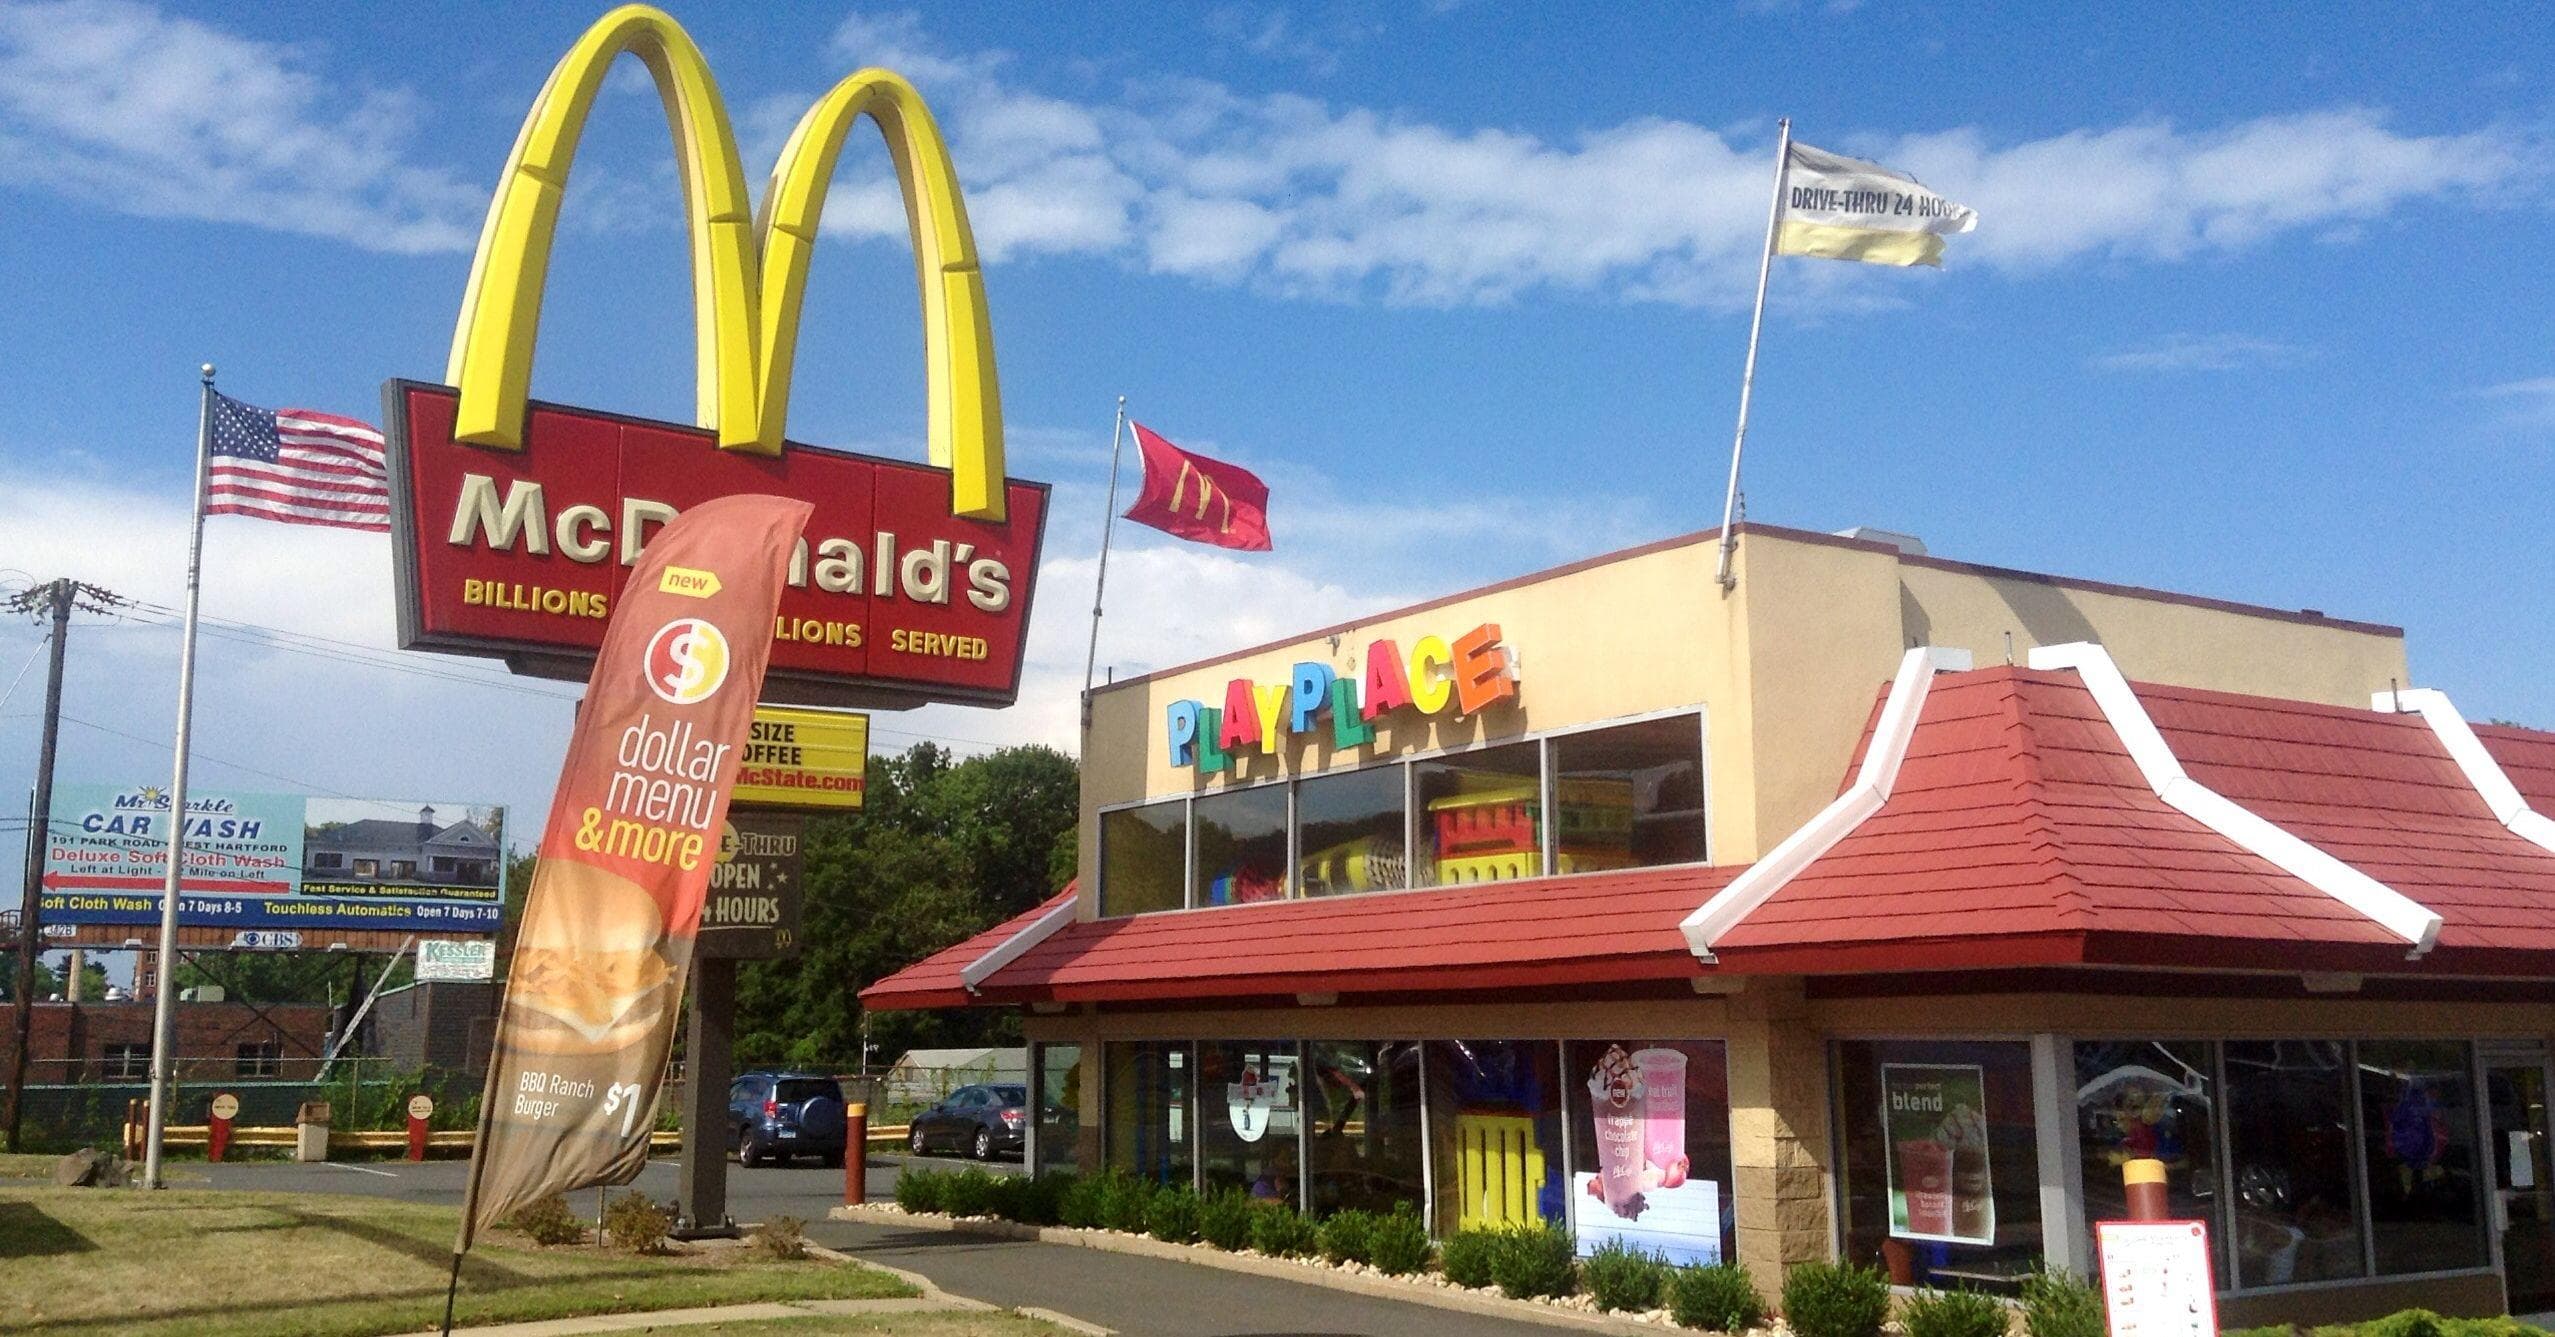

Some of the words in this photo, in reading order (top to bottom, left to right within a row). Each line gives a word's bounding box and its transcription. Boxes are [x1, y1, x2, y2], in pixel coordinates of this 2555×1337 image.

[1791, 186, 1888, 215] DRIVE-THRU
[1893, 193, 1913, 216] 24
[447, 472, 1011, 612] McDald's
[668, 573, 709, 591] new
[463, 578, 607, 619] BILLIONS
[776, 615, 862, 648] LIONS
[891, 628, 989, 662] SERVED
[751, 721, 794, 744] SIZE
[618, 714, 731, 784] dollar
[741, 743, 801, 766] OFFEE
[153, 795, 234, 813] Sarkle
[605, 769, 718, 830] menu
[82, 813, 152, 835] CAR
[80, 837, 117, 847] PARK
[123, 838, 160, 848] ROAD
[183, 841, 211, 851] EST
[215, 842, 288, 853] HARTFORD
[721, 832, 797, 857] E-THRU
[51, 848, 121, 863] Deluxe
[128, 850, 168, 864] Soft
[234, 854, 285, 868] Wash
[70, 864, 98, 874] Left
[101, 865, 115, 874] at
[118, 864, 153, 877] Light
[189, 867, 216, 878] Mile
[219, 869, 236, 879] on
[240, 869, 266, 880] Left
[710, 864, 760, 890] OPEN
[303, 884, 326, 893] Fast
[328, 884, 366, 895] Service
[368, 886, 377, 895] &
[379, 886, 438, 897] Satisfaction
[440, 888, 497, 899] Guaranteed
[69, 897, 108, 910] Cloth
[113, 897, 152, 911] Wash
[188, 900, 195, 912] 7
[198, 901, 222, 915] Days
[224, 901, 242, 914] 8-5
[264, 901, 333, 916] Touchless
[337, 903, 412, 917] Automatics
[417, 904, 442, 919] Open
[444, 906, 450, 917] 7
[452, 907, 475, 920] Days
[477, 907, 498, 919] 7-10
[716, 898, 779, 924] HOURS
[262, 933, 293, 947] CBS
[520, 1071, 546, 1093] BBQ
[549, 1075, 595, 1099] Ranch
[514, 1095, 559, 1120] Burger
[603, 1082, 641, 1138] $1
[1891, 1090, 1943, 1113] blend
